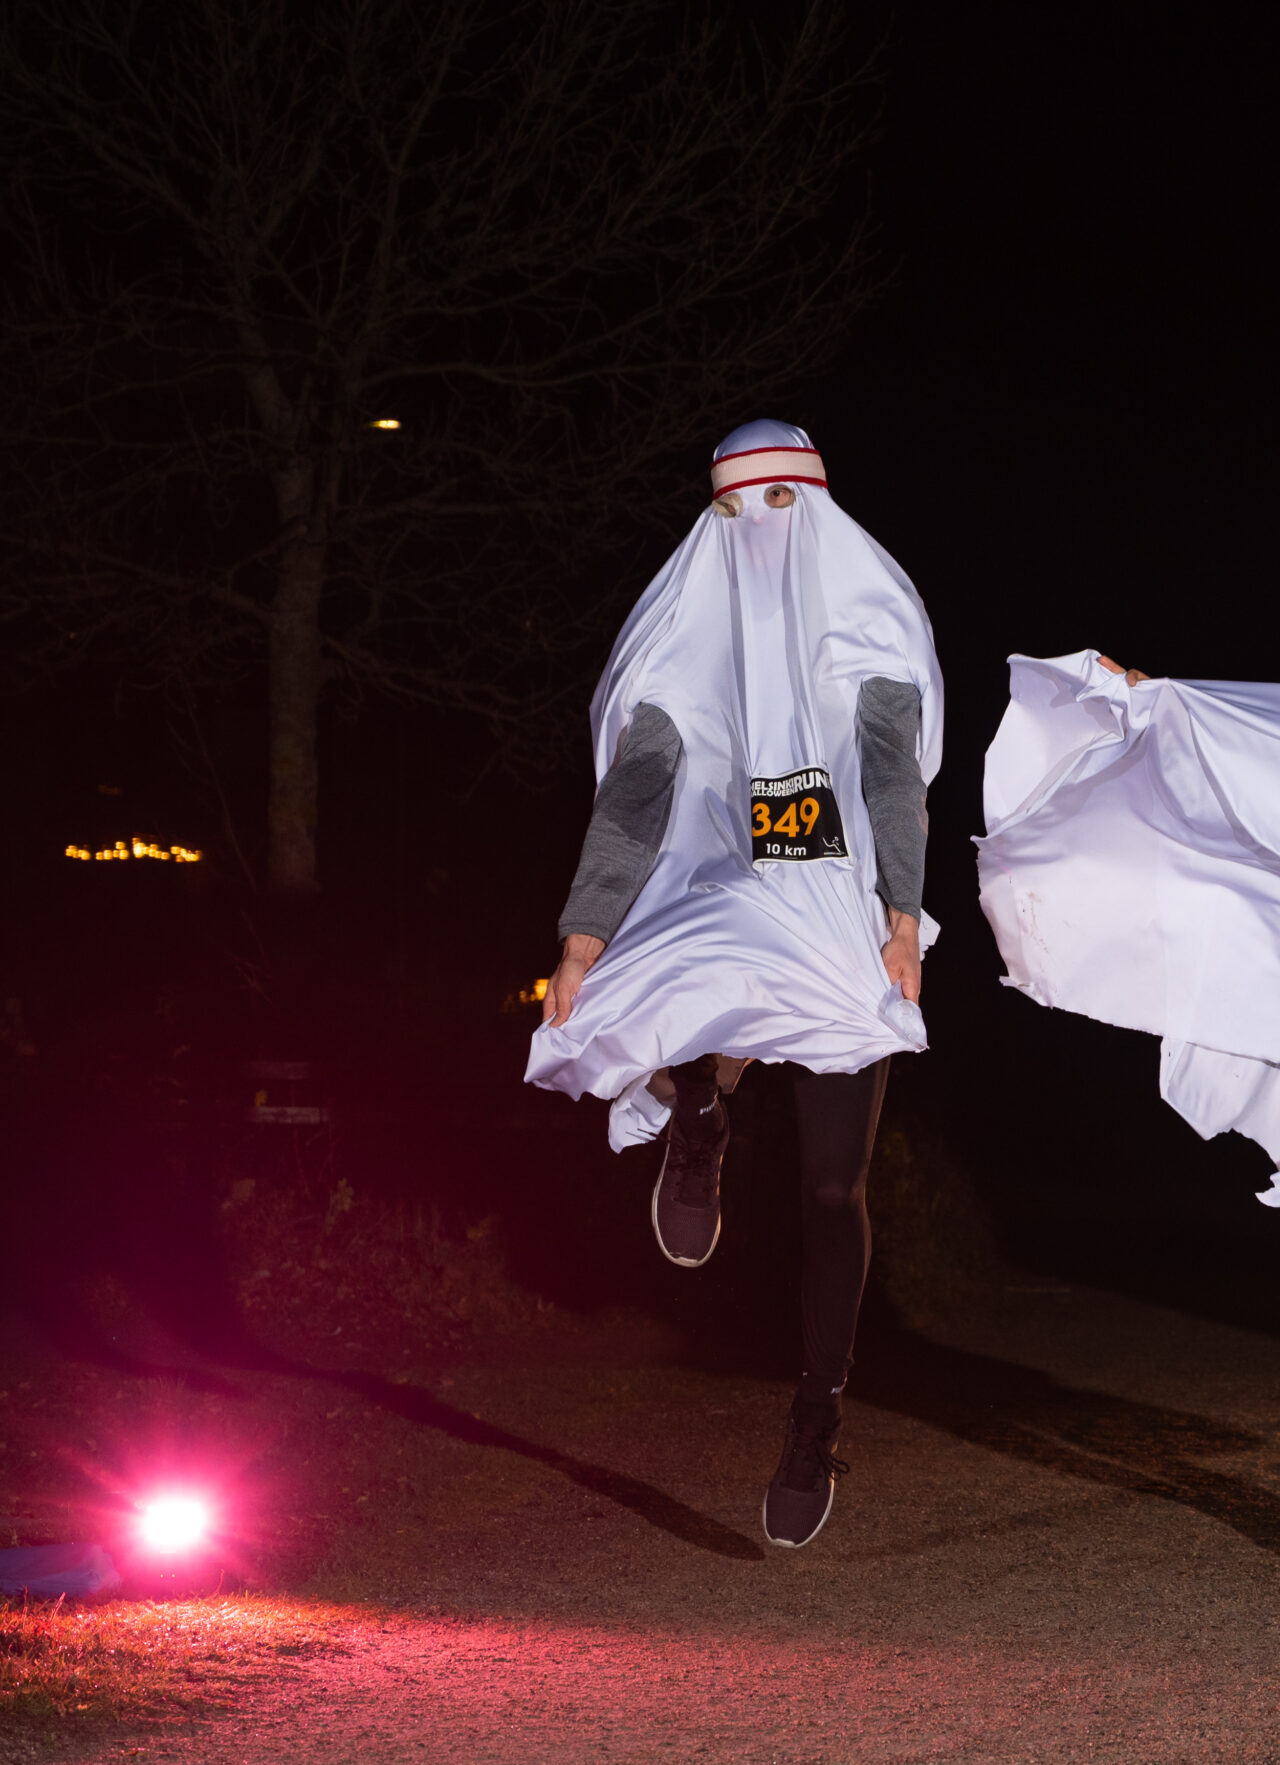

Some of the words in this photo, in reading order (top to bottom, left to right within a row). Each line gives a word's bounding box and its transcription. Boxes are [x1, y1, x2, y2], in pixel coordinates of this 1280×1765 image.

[794, 771, 827, 792] RUN
[752, 787, 795, 797] ALLOWEEN
[752, 797, 820, 838] 349
[766, 843, 780, 855] 10
[785, 843, 806, 856] km
